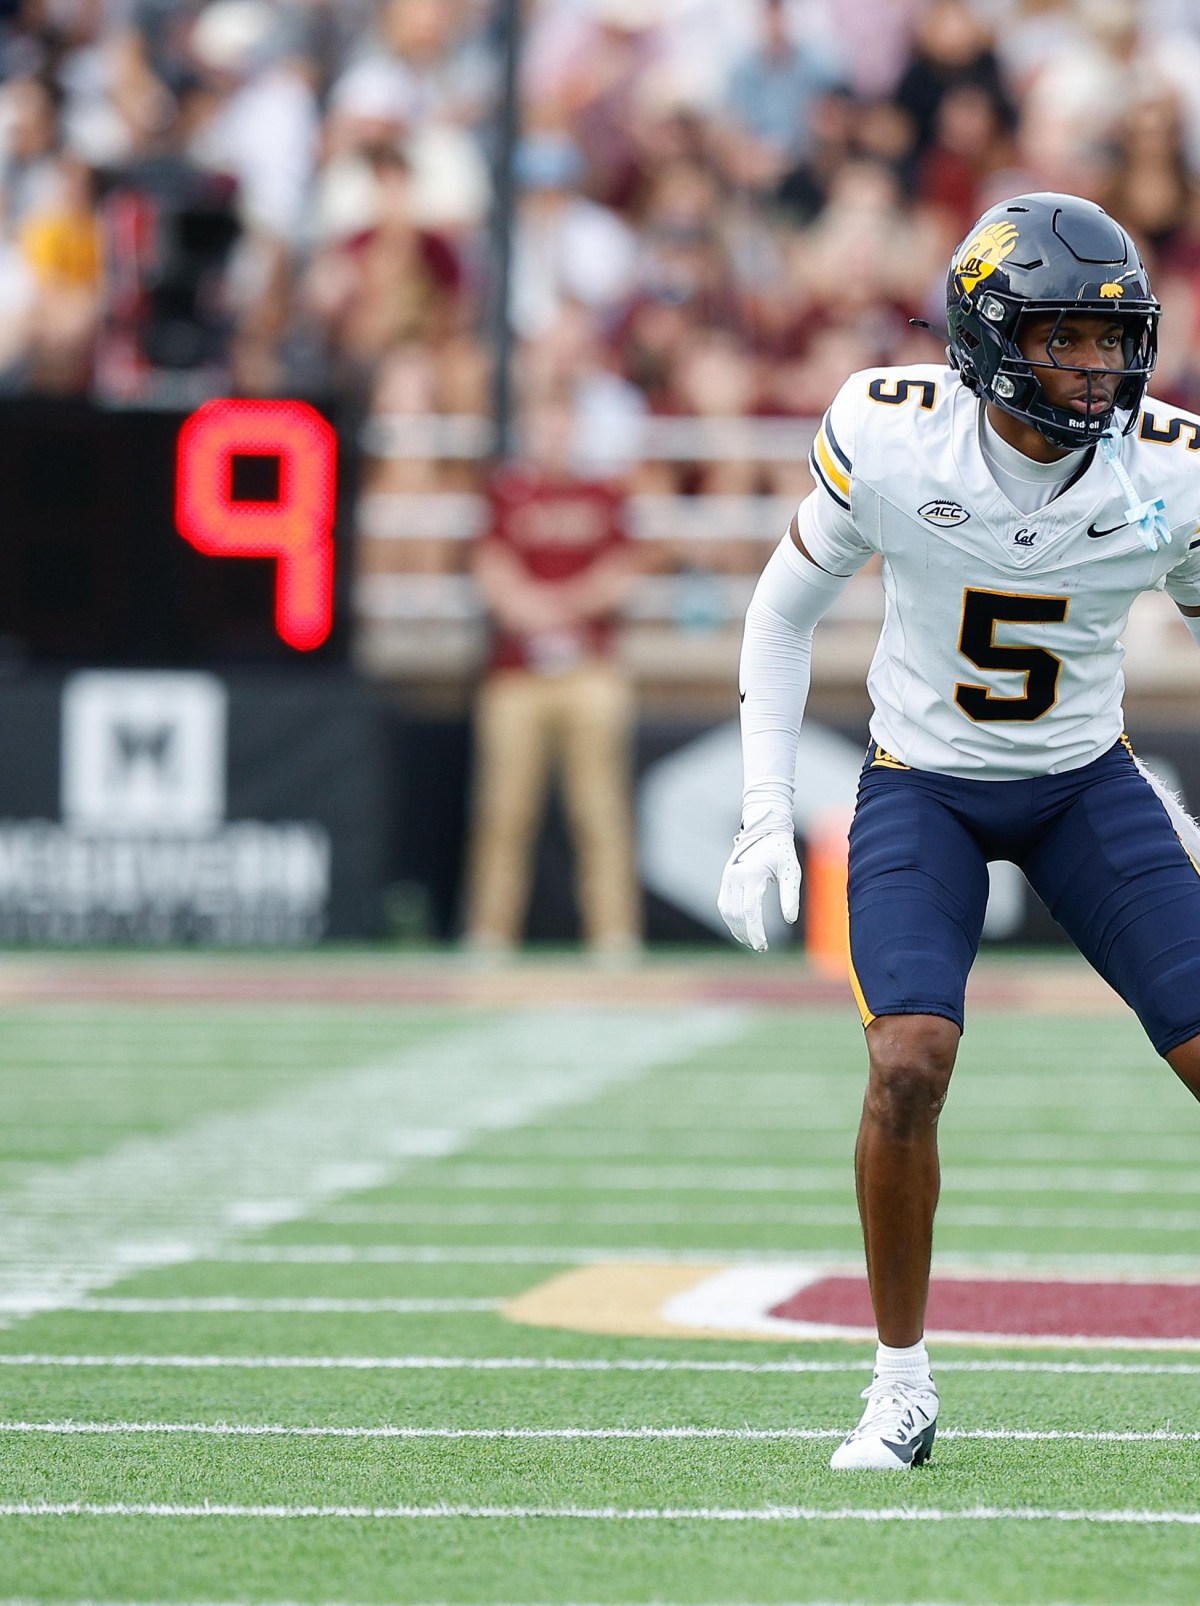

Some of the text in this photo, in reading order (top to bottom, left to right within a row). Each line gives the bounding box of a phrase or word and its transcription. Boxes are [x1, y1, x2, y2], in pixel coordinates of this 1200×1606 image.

[868, 377, 936, 411] 5
[1069, 418, 1100, 429] Ridell
[176, 399, 338, 651] 9
[925, 507, 963, 518] ACC
[1013, 528, 1038, 546] Cal
[954, 587, 1070, 722] 5
